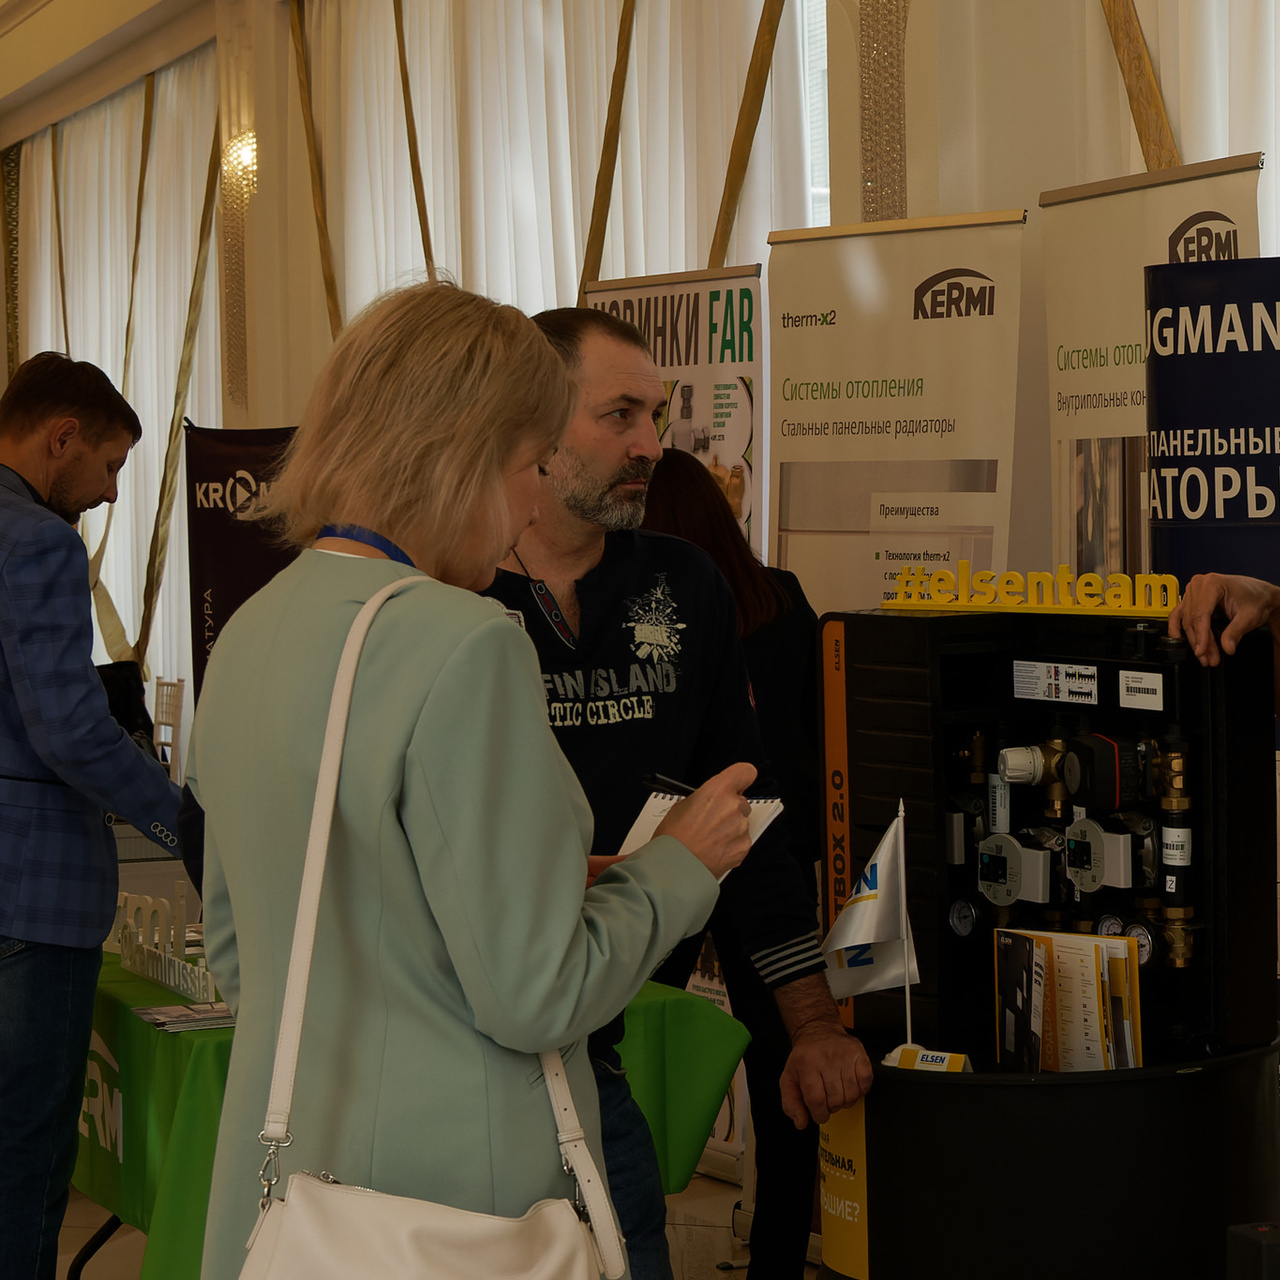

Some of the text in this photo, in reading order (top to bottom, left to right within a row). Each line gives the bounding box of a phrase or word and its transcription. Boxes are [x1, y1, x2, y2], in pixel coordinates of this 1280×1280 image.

[1168, 210, 1239, 263] KERMI
[913, 268, 996, 320] KERMI
[593, 287, 754, 368] ИНКИ FAR
[782, 310, 837, 328] therm-x2
[1056, 345, 1110, 373] Системы
[782, 377, 925, 401] Системы отопления
[1057, 390, 1129, 416] Внутрипольные
[781, 418, 956, 440] Стальные панельные радиаторы
[879, 504, 940, 519] Преимущества
[894, 559, 1180, 609] #elsenteam
[833, 638, 842, 671] ELSEN
[590, 662, 678, 699] ISLAND
[549, 695, 654, 727] TIC CIRCLE
[831, 769, 845, 823] 2.0
[920, 1054, 946, 1065] ELSEN
